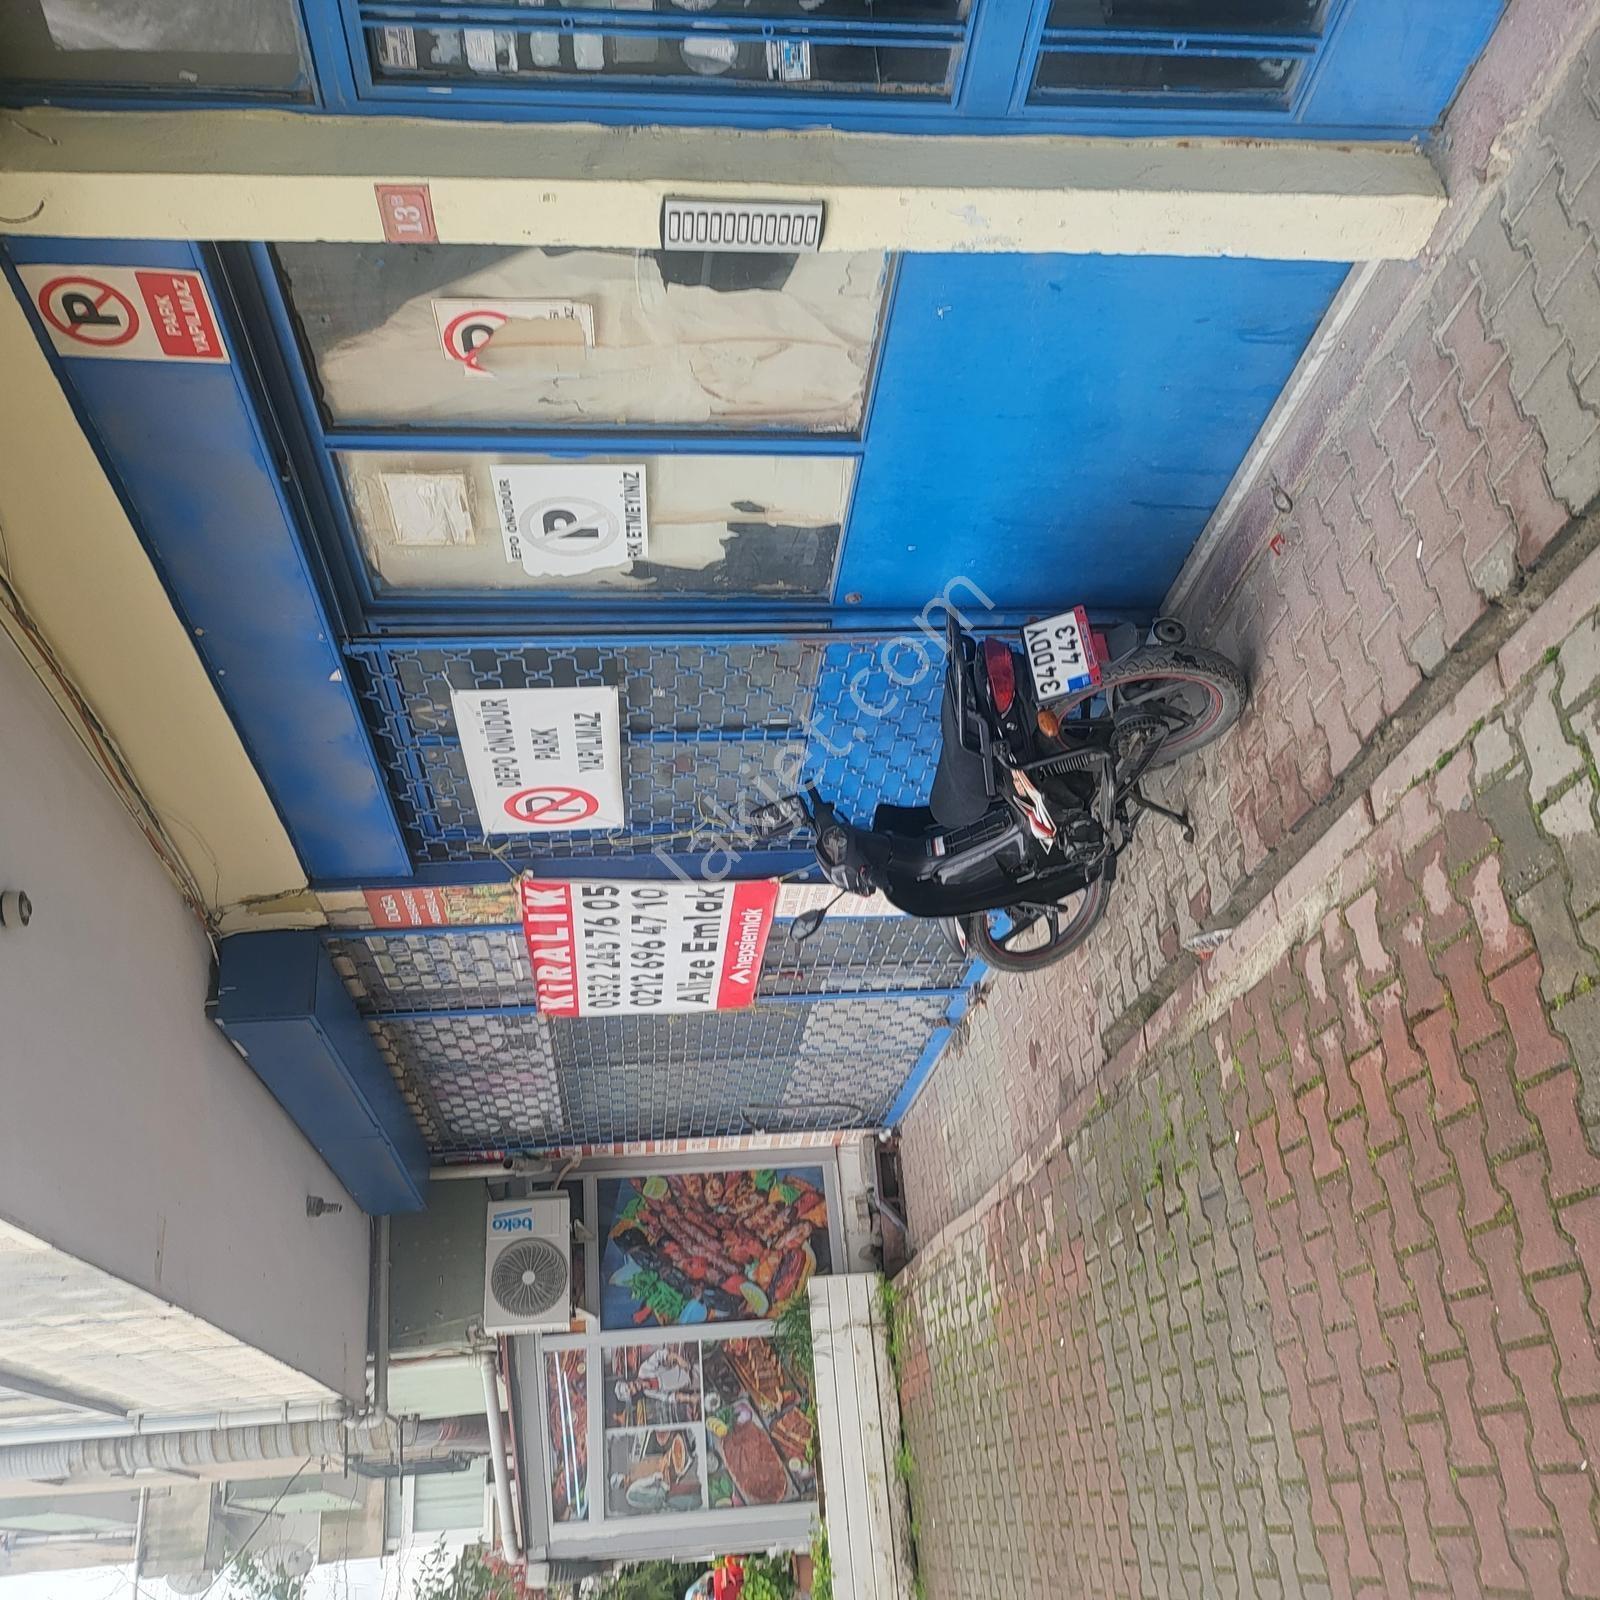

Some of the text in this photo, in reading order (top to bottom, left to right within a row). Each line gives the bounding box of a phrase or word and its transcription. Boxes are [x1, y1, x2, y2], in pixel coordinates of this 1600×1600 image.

[154, 294, 182, 336] PARK
[172, 277, 210, 353] YAPILMAZ
[499, 478, 522, 559] EPO ÖNÜDÜR
[619, 472, 642, 558] RK ETMEYİNİZ
[1055, 625, 1081, 664] 443
[476, 697, 522, 787] DEPO ÖNÜDÜR
[530, 728, 560, 760] PARK
[574, 712, 604, 773] YAPILMAZ
[582, 886, 620, 910] 05
[584, 917, 620, 937] 76
[630, 888, 668, 1006] 0212 696 47 10
[677, 887, 725, 1005] Alize Emlak
[731, 908, 763, 969] hepsiemlak
[587, 974, 621, 1008] 0532
[492, 1217, 532, 1233] beko
